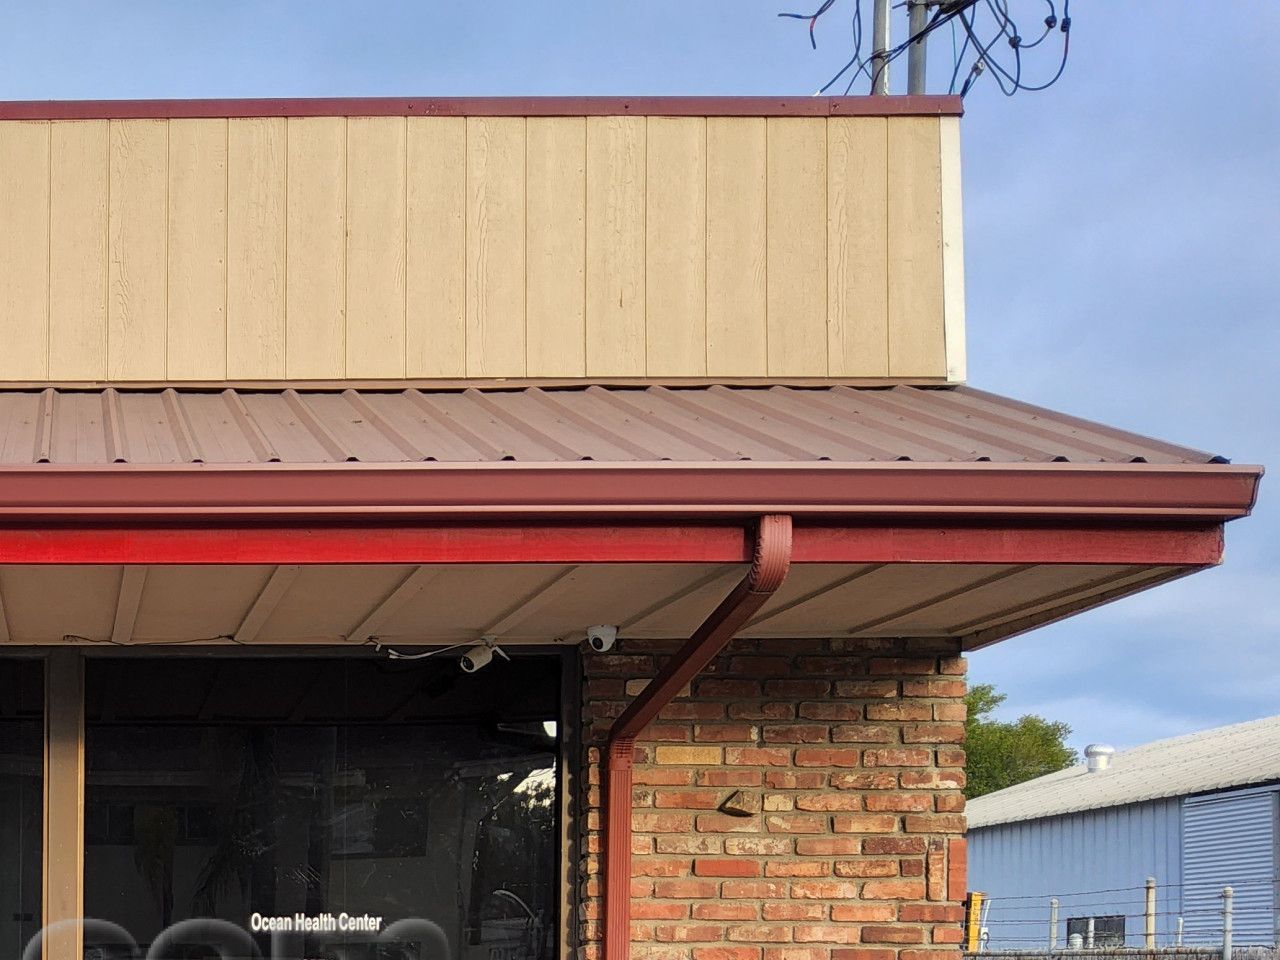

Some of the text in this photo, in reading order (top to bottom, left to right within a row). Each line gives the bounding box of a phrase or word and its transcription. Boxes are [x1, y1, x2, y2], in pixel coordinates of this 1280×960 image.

[251, 912, 382, 931] Ocean Health Center
